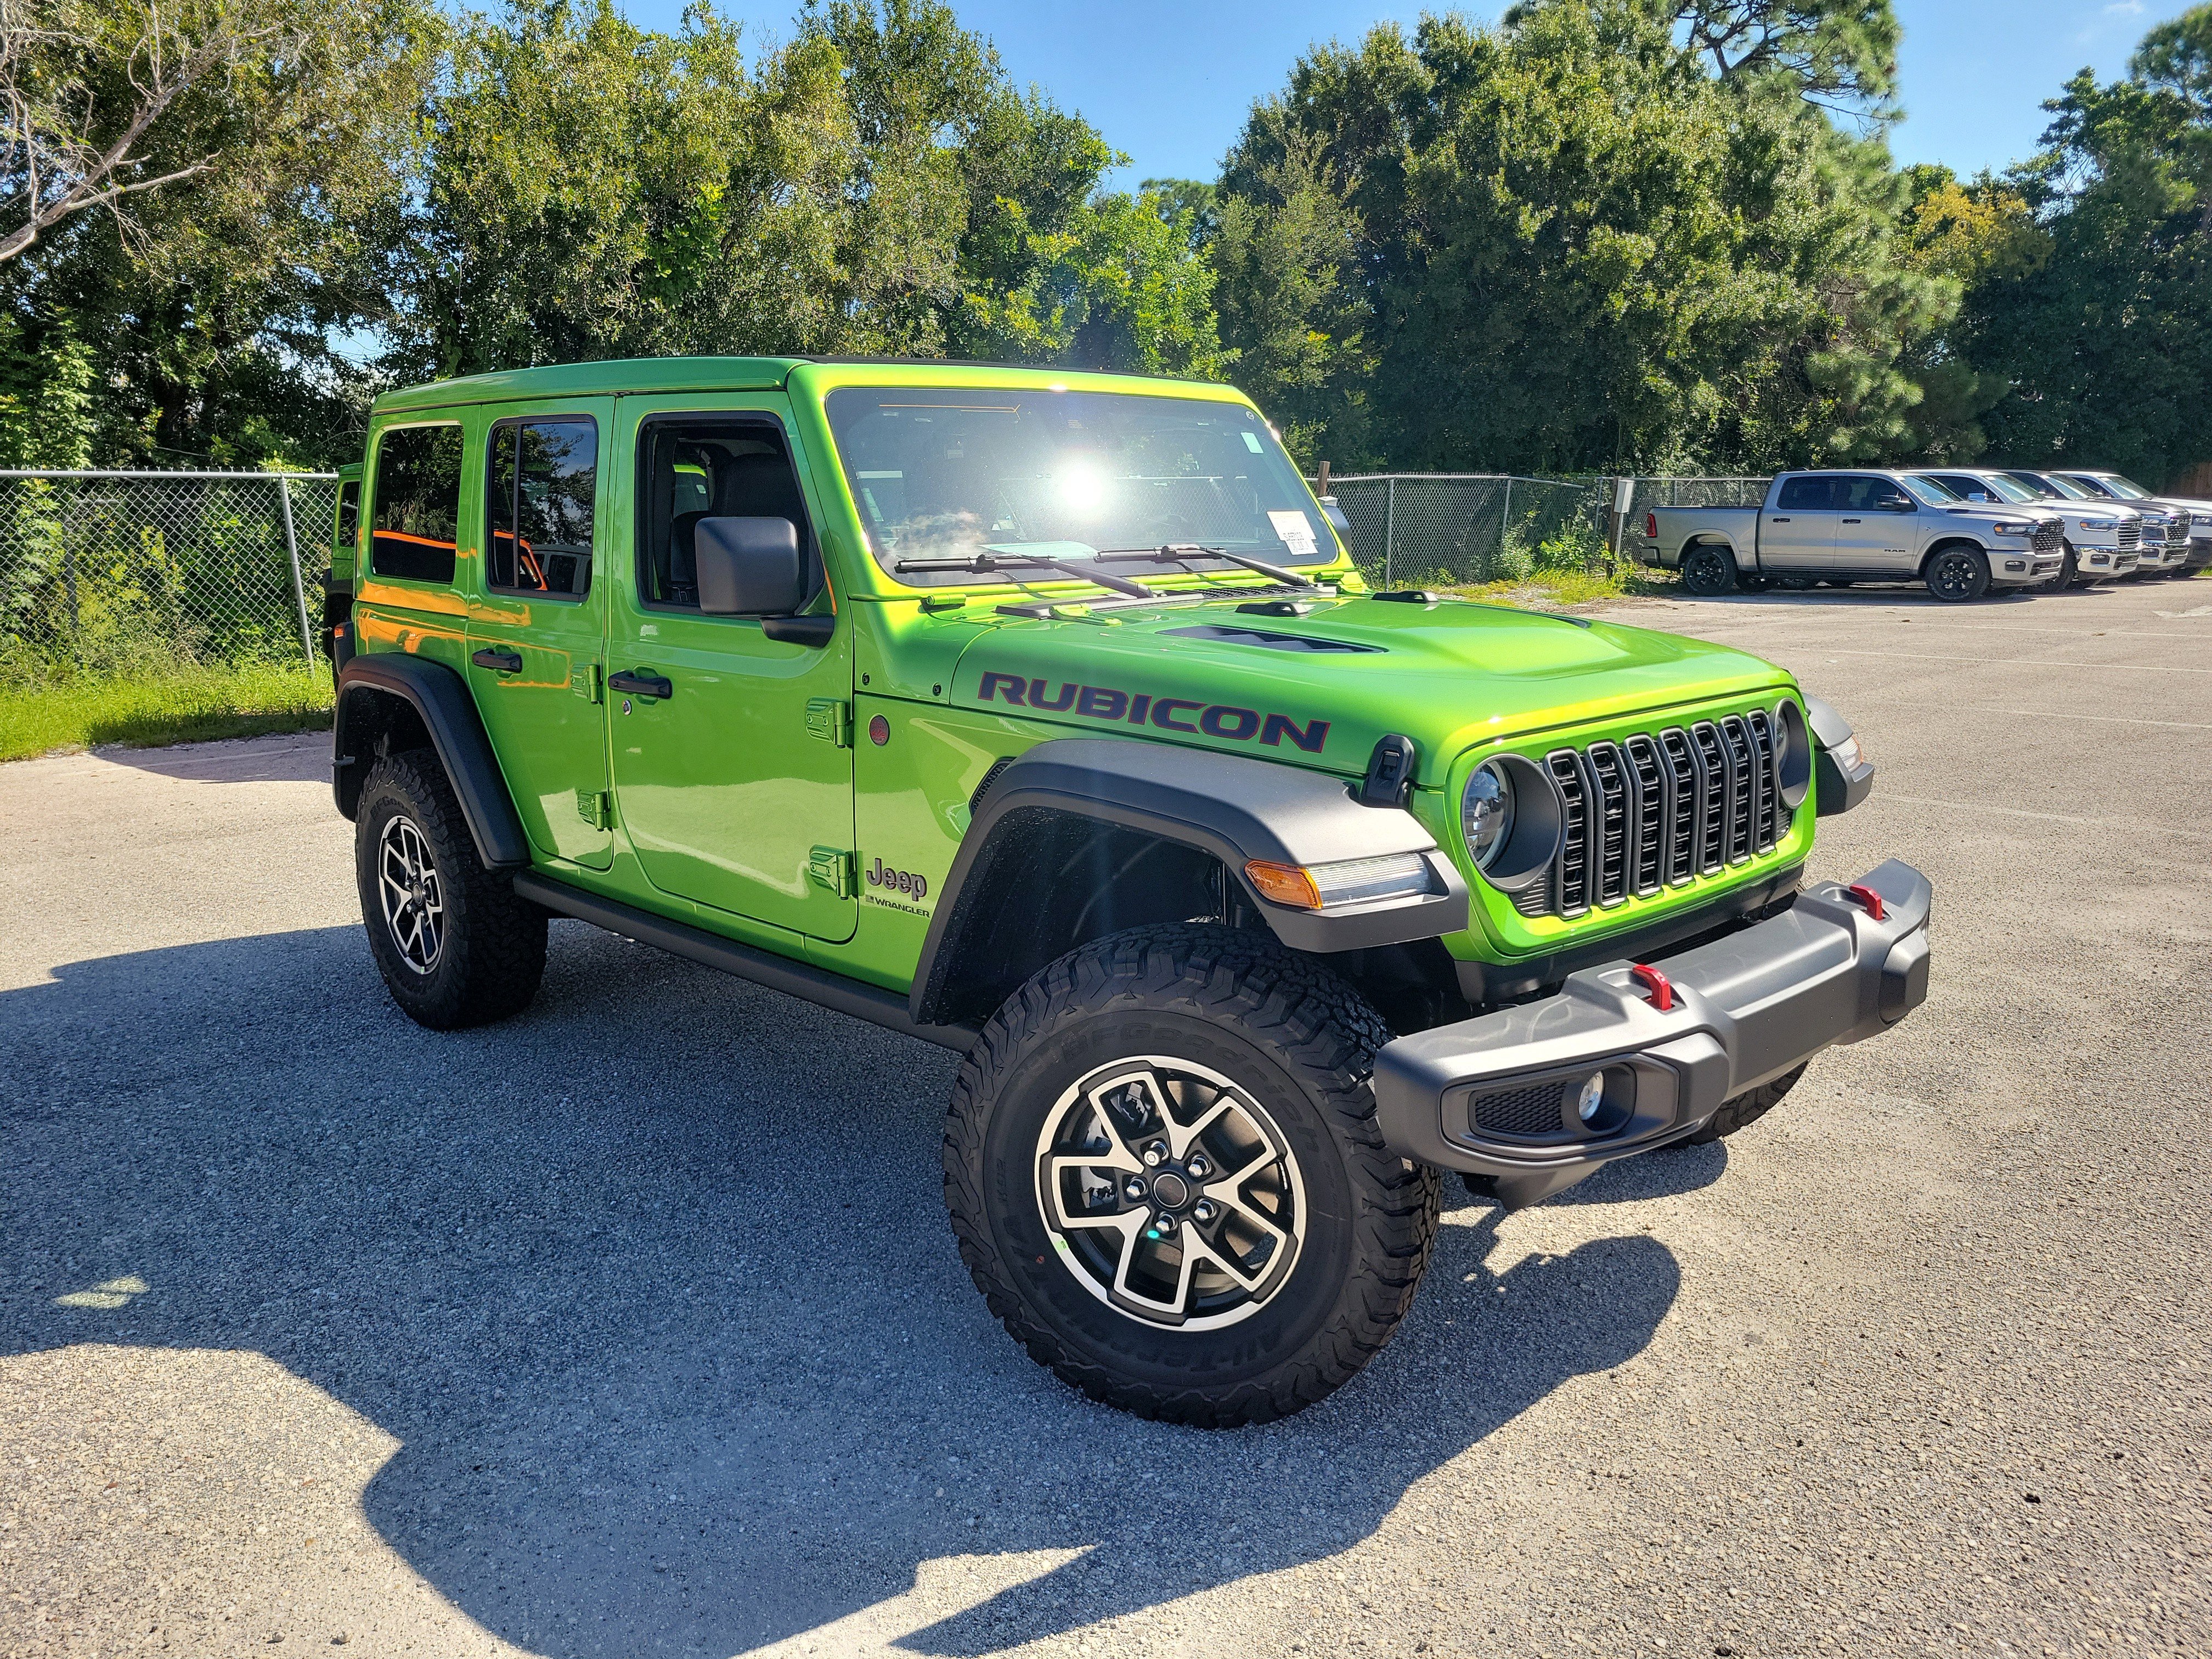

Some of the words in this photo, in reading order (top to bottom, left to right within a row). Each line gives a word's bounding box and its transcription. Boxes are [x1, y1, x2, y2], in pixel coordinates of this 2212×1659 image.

[977, 670, 1331, 754] RUBICON
[866, 857, 927, 902] Jeep
[874, 897, 930, 918] WRANGLER
